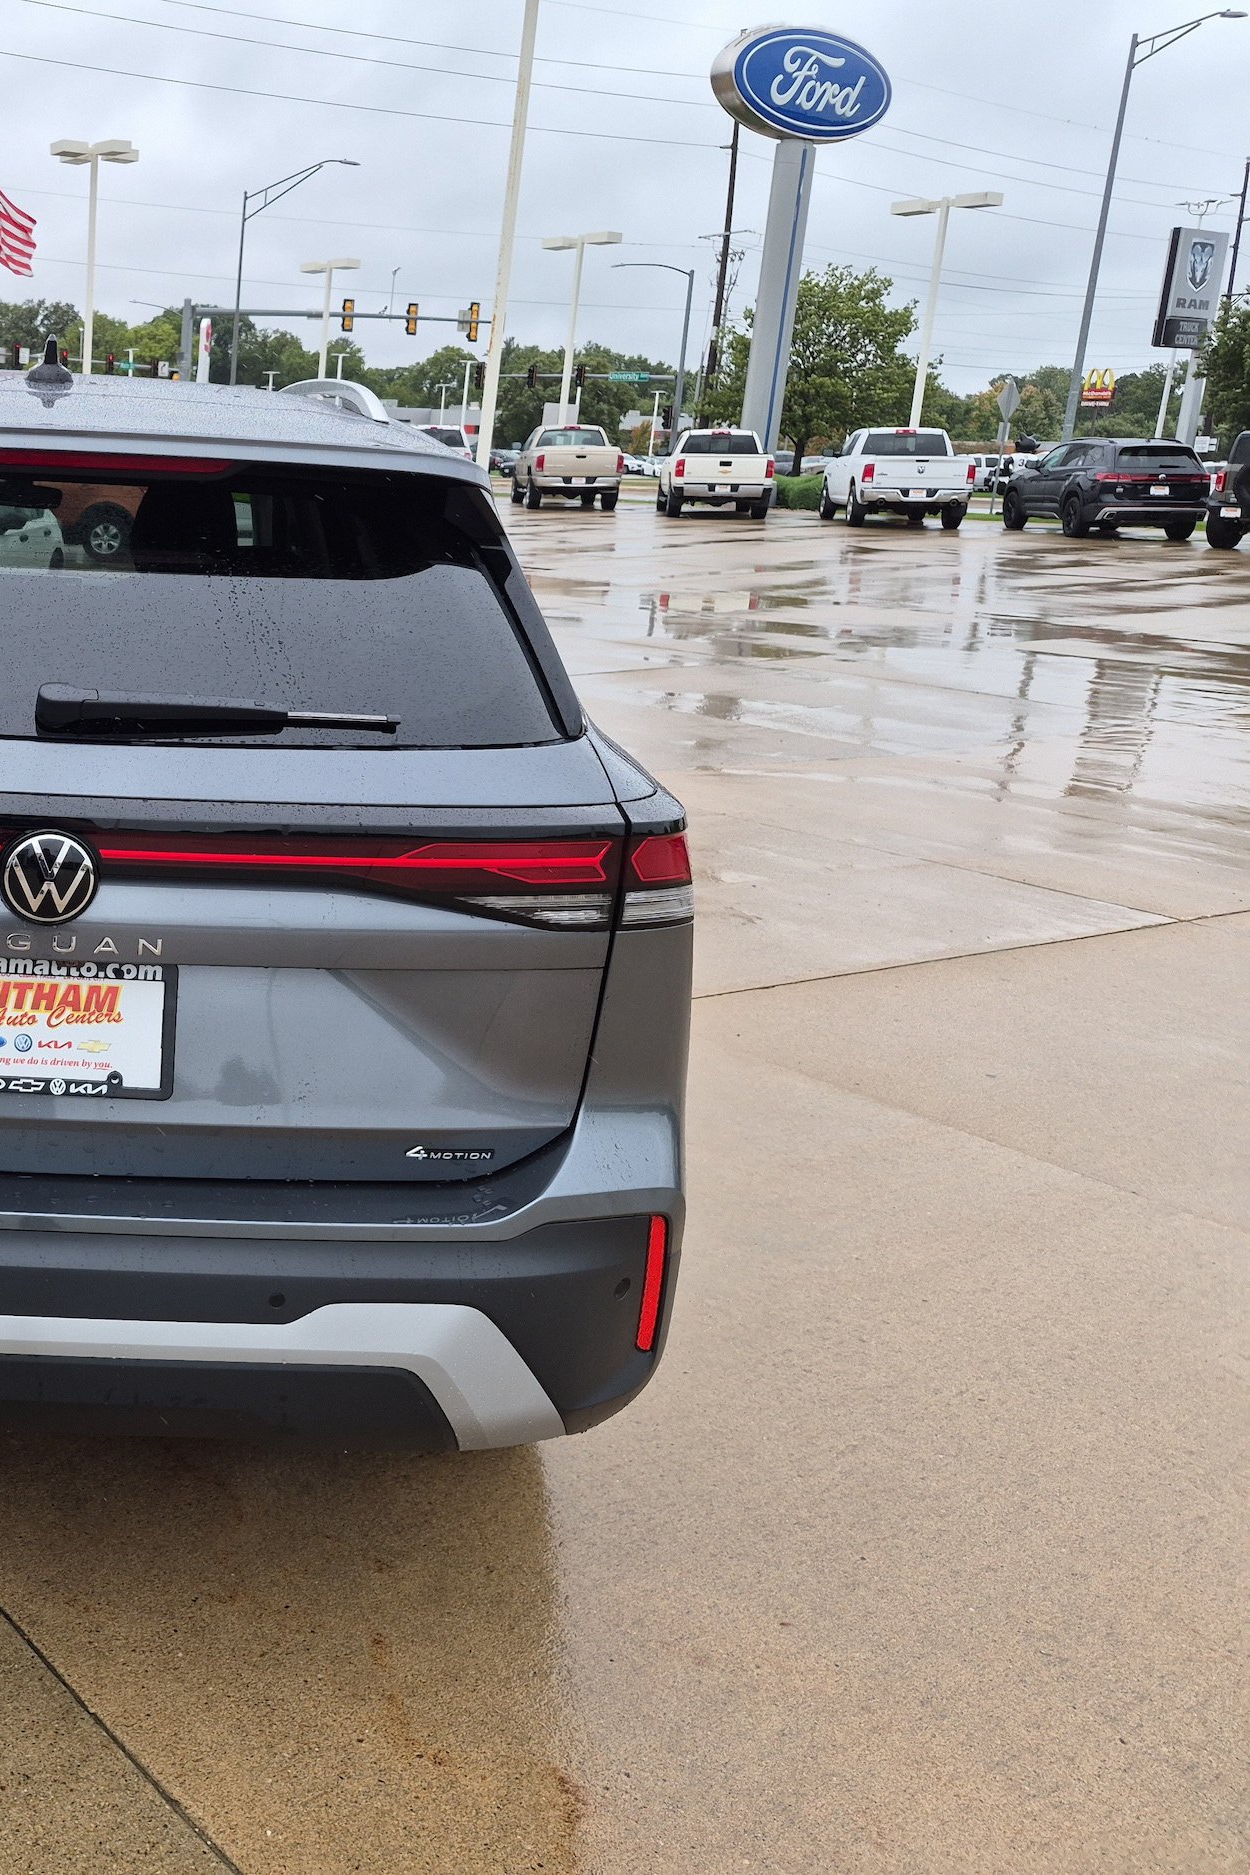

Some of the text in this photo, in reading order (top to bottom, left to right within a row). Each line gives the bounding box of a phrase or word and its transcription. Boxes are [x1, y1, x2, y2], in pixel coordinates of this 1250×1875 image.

[770, 45, 866, 118] Ford
[1175, 297, 1210, 311] RAM
[1179, 321, 1200, 333] TRUCK
[609, 372, 639, 380] University
[46, 1005, 125, 1029] Centers
[12, 1057, 26, 1065] we
[27, 1057, 39, 1066] do
[40, 1058, 49, 1066] is
[50, 1058, 80, 1068] driven
[81, 1060, 93, 1069] by
[93, 1061, 114, 1071] you.
[405, 1145, 492, 1161] 4MOTION
